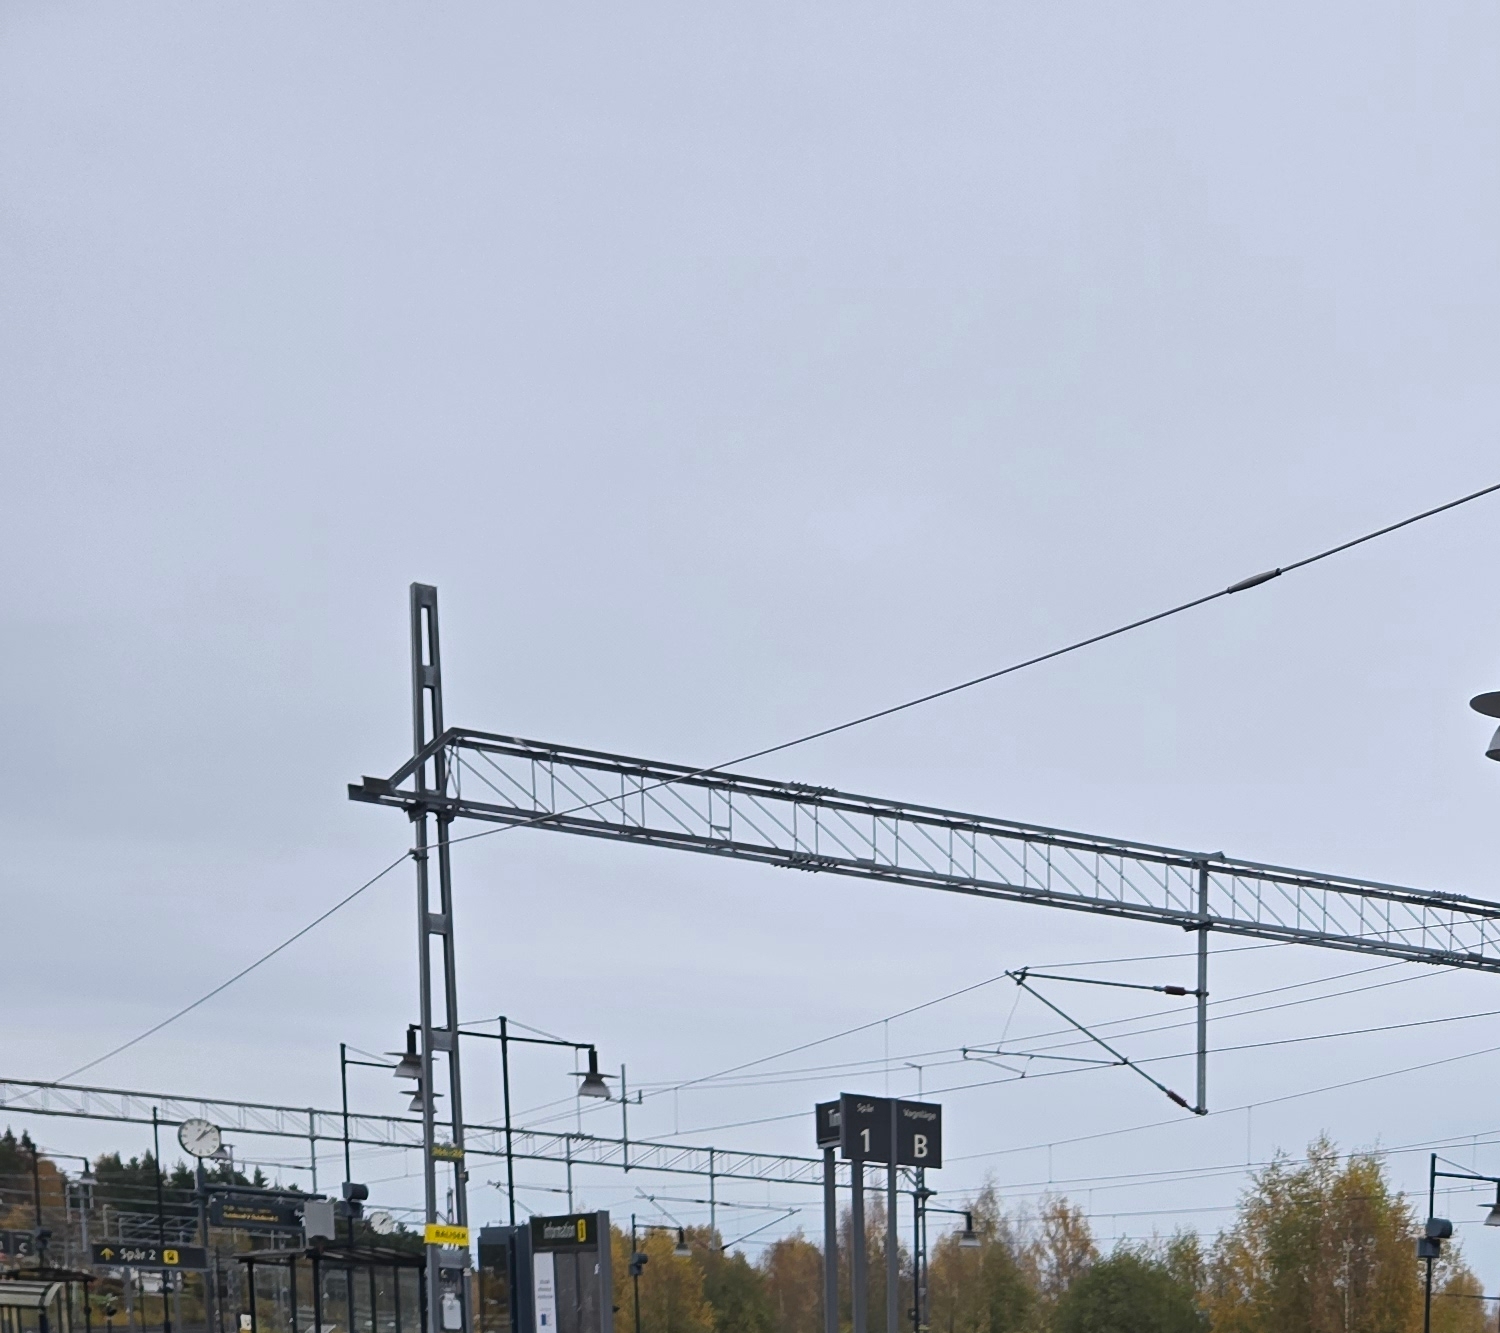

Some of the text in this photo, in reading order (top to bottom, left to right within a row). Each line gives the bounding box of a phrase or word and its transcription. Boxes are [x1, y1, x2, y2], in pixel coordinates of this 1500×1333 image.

[860, 1128, 871, 1153] 1
[913, 1134, 928, 1158] B
[119, 1247, 156, 1262] Spår 2
